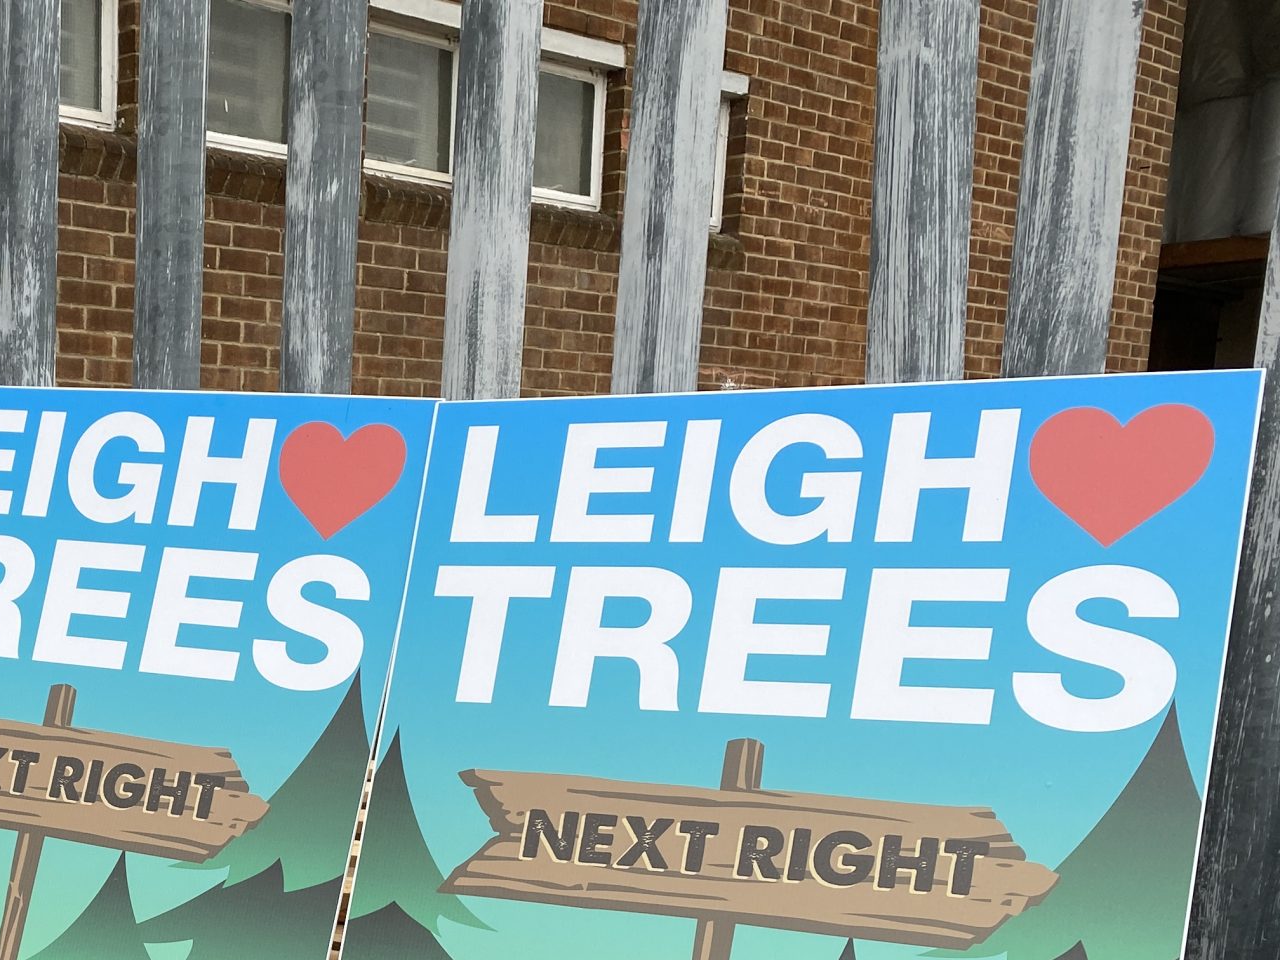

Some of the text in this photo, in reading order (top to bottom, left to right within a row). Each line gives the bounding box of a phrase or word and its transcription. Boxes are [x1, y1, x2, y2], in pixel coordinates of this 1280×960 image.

[449, 407, 1022, 545] LEIGH
[434, 563, 1180, 734] TREES
[48, 755, 226, 823] RIGHT
[520, 808, 990, 899] NEXT RIGHT
